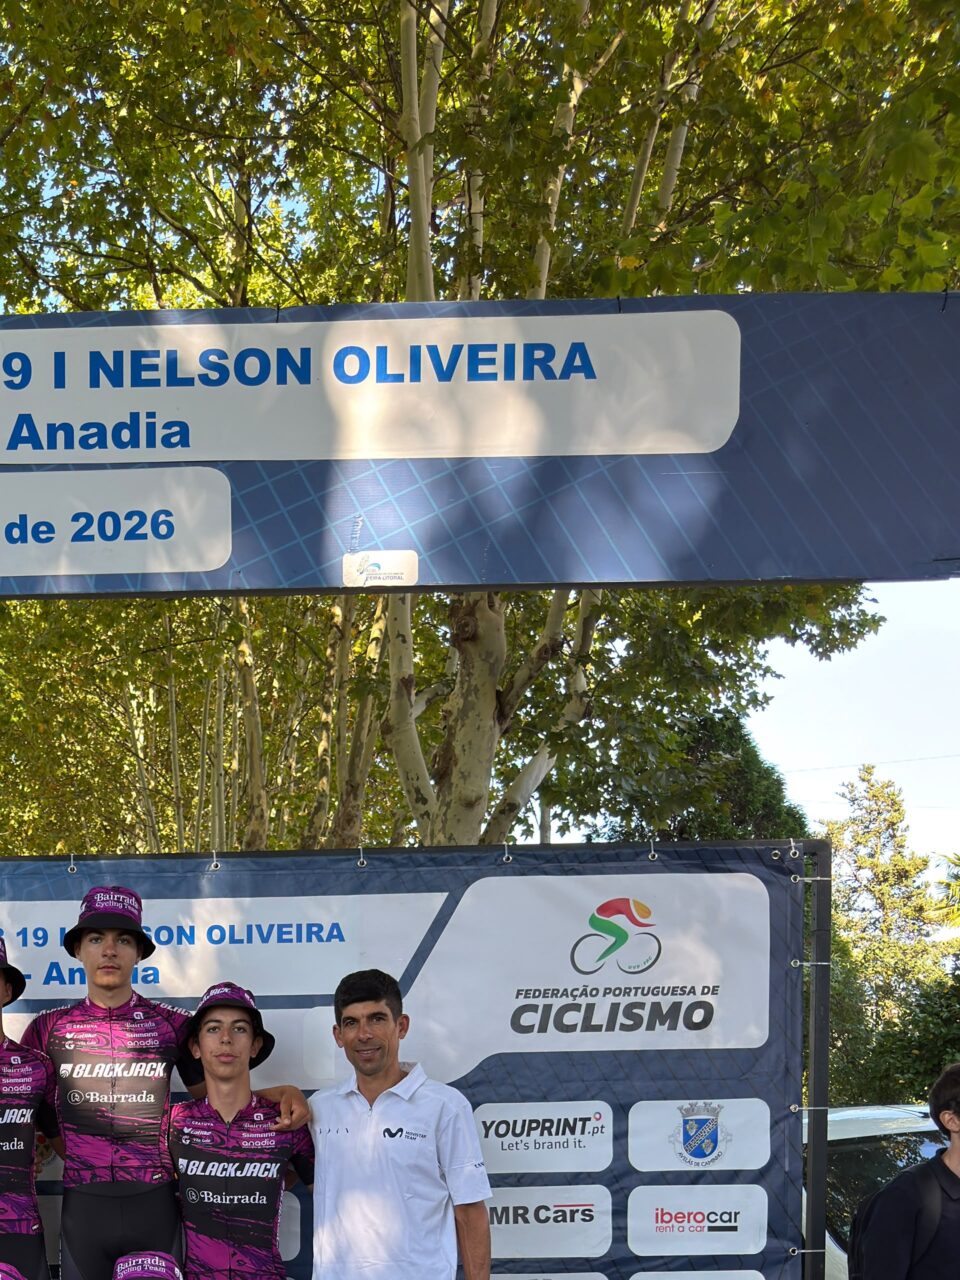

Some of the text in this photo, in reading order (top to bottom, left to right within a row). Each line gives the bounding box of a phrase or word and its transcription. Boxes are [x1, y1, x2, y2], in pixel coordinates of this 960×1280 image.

[90, 347, 312, 390] NELSON
[333, 342, 597, 385] OLIVEIRA
[6, 411, 190, 452] Anadia
[4, 514, 56, 545] de
[71, 510, 175, 544] 2026
[16, 926, 49, 948] 19
[206, 922, 345, 946] OLIVEIRA
[42, 961, 160, 987] Ania
[515, 985, 721, 1001] FEDERAÇÃO PORTUGUESA DE
[510, 1000, 715, 1034] CICLISMO
[73, 1062, 167, 1079] BLACKJACK
[85, 1091, 156, 1104] Bairrada
[481, 1116, 606, 1139] YOUPRINT.pt
[242, 1138, 276, 1147] anadia
[500, 1138, 587, 1151] Let's brand it.
[187, 1160, 281, 1179] BLACKJACK
[200, 1190, 267, 1205] Bairrada
[489, 1204, 595, 1225] MR Cars
[655, 1208, 741, 1224] iberocar
[655, 1225, 706, 1233] rent a car
[116, 1256, 166, 1273] Bairrada
[143, 1263, 166, 1274] Team
